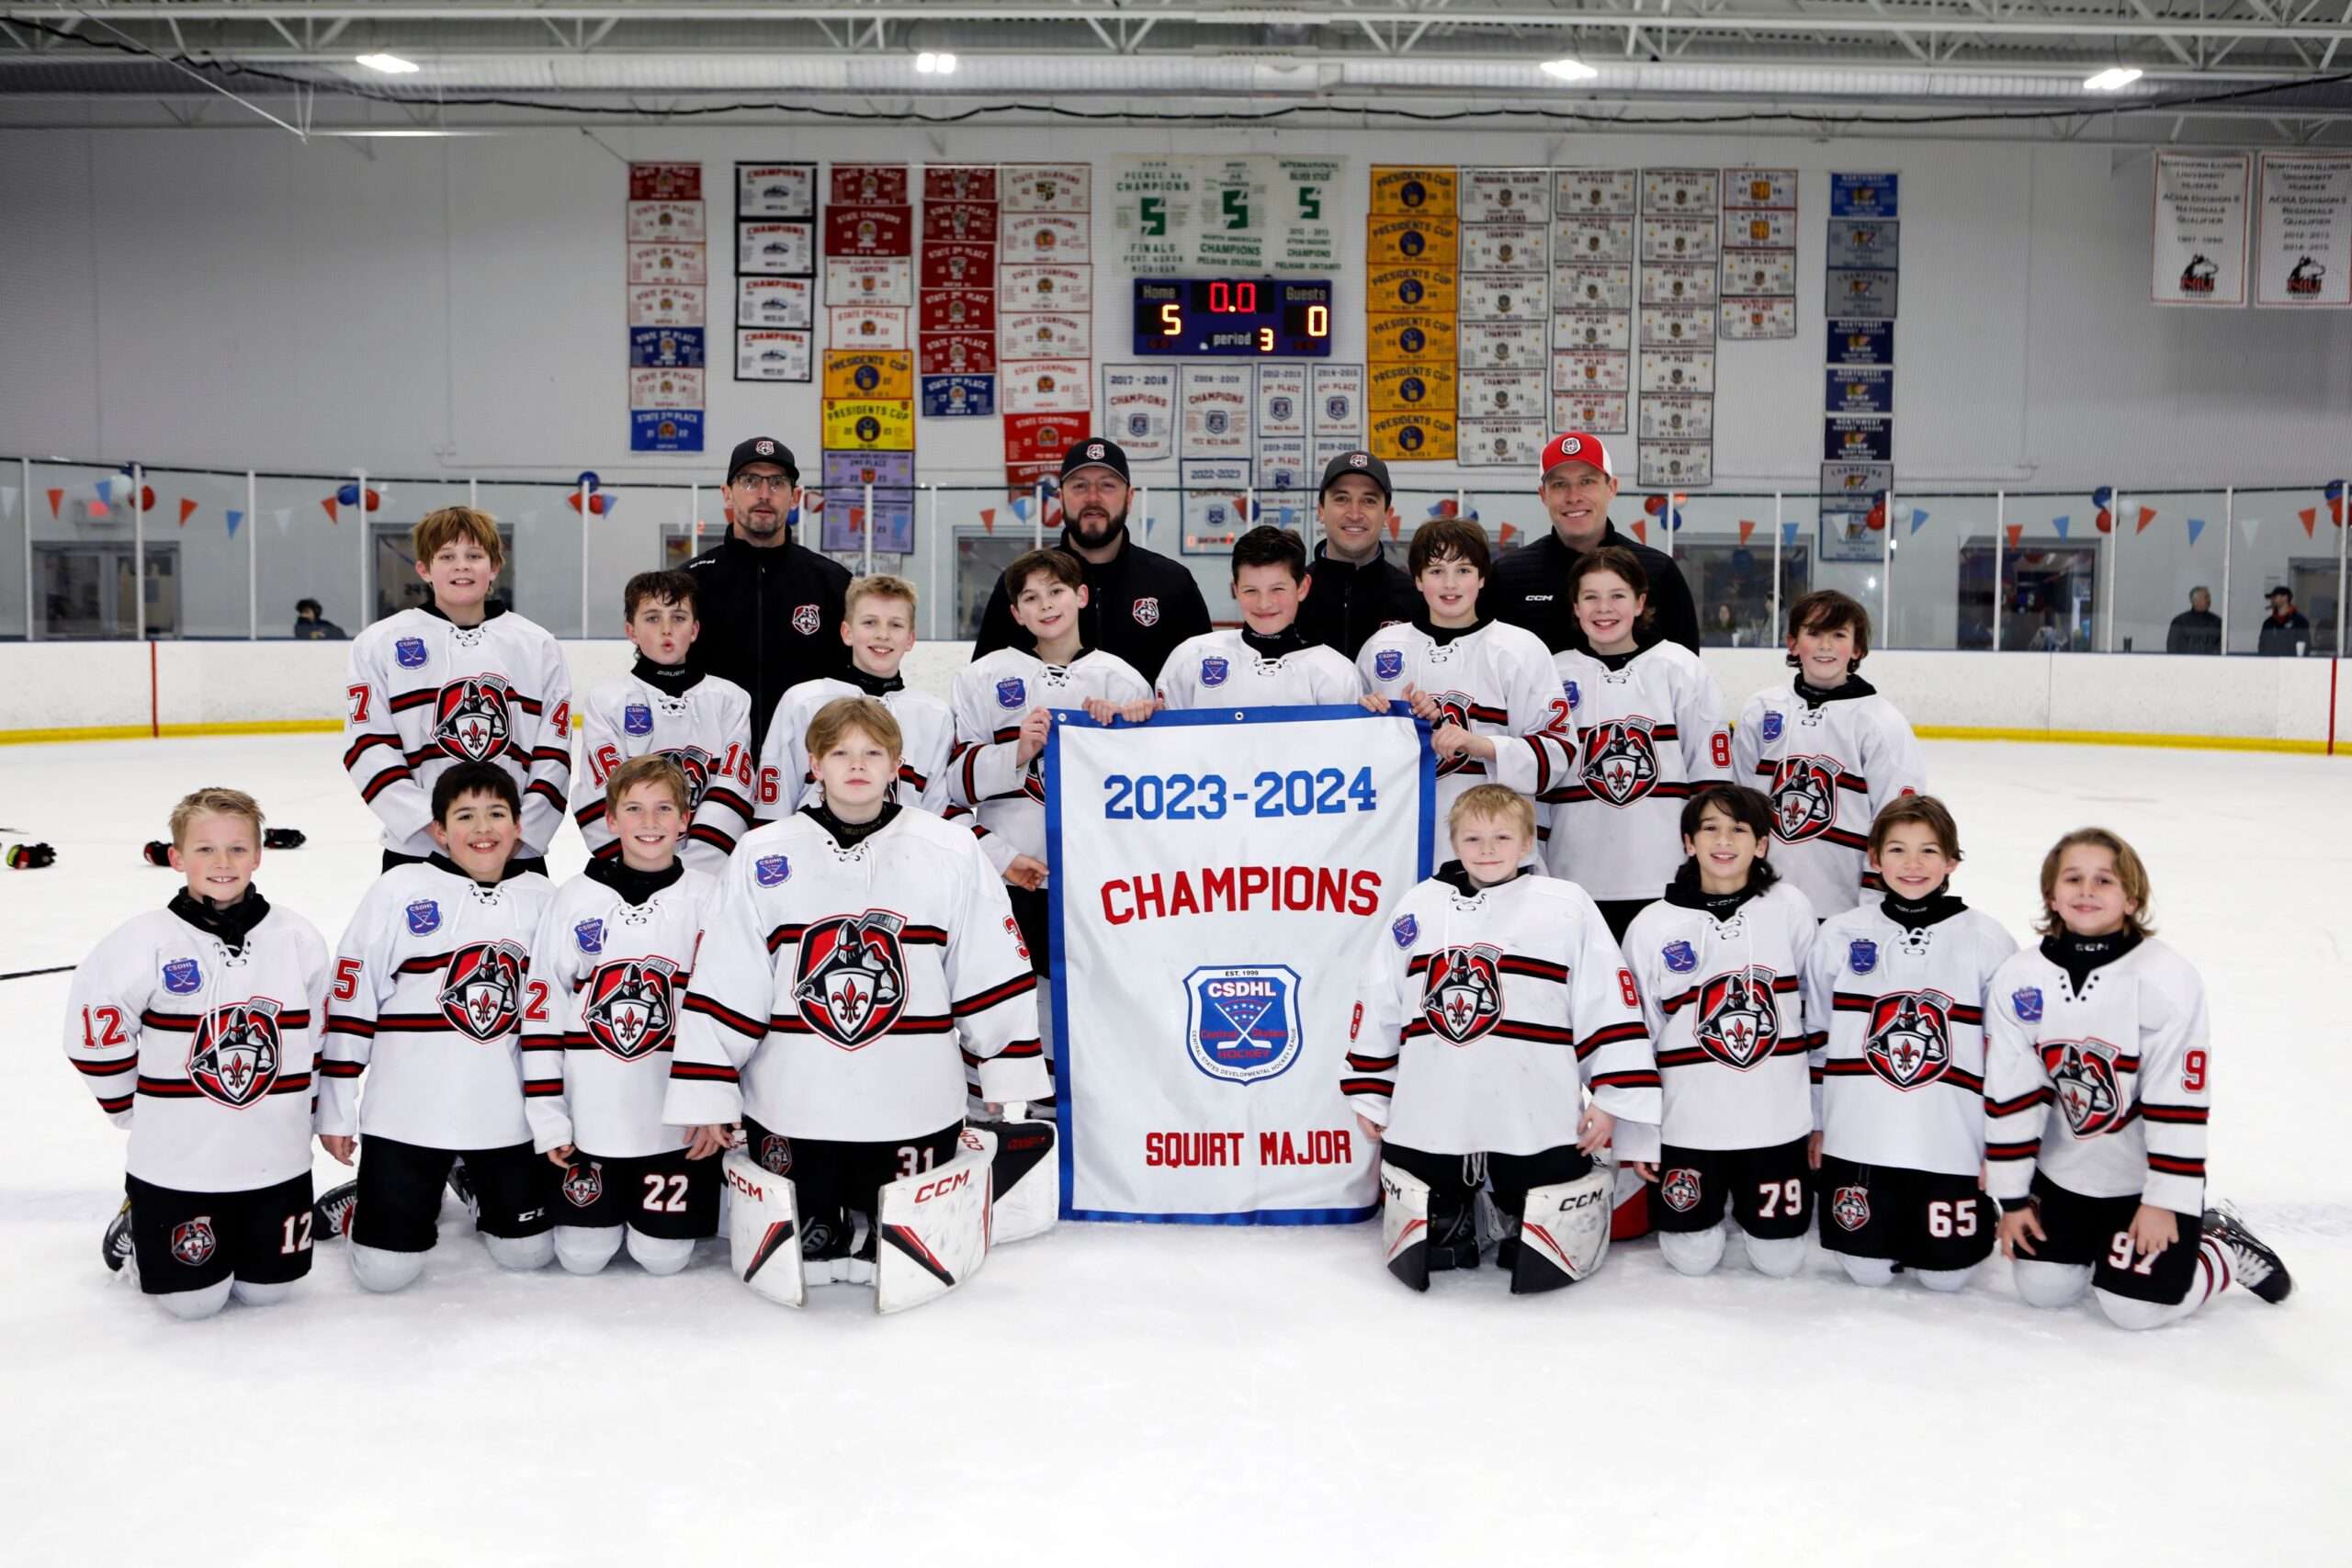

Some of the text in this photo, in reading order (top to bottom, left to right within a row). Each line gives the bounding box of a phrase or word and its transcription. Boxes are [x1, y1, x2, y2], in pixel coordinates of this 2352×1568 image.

[1116, 182, 1190, 191] CHAMPIONS
[1200, 243, 1261, 255] CHAMPIONS
[1143, 286, 1176, 299] Home
[1209, 283, 1256, 312] 0.0
[1286, 287, 1327, 300] Guests
[1162, 304, 1182, 334] 5
[1213, 327, 1274, 350] period 3
[1307, 306, 1328, 336] 0
[1111, 393, 1167, 407] CHAMPIONS
[1189, 391, 1244, 404] CHAMPIONS
[347, 683, 372, 725] 7
[550, 699, 571, 738] 4
[1548, 699, 1570, 736] 2
[719, 741, 754, 787] 16
[1710, 730, 1734, 769] 8
[755, 766, 781, 806] 6
[1103, 766, 1377, 820] 2023-2024
[1101, 865, 1383, 926] CHAMPIONS
[333, 956, 365, 1003] 5
[1207, 981, 1277, 998] CSDHL
[1616, 966, 1640, 1010] 8
[521, 976, 552, 1023] 2
[81, 1003, 127, 1051] 12
[1191, 1028, 1297, 1077] CENTRAL STATES DEVELOPMENTAL HOCKEY LEAGUE
[1216, 1049, 1272, 1059] HOCKEY
[2181, 1049, 2210, 1095] 9
[895, 1145, 937, 1182] 31
[1146, 1129, 1353, 1169] SQUIRT MAJOR
[642, 1174, 691, 1213] 22
[728, 1168, 764, 1203] CCM
[913, 1168, 971, 1205] CCM
[1558, 1188, 1605, 1213] CCM
[1757, 1178, 1804, 1220] 79
[279, 1210, 315, 1256] 12
[1928, 1198, 1979, 1239] 65
